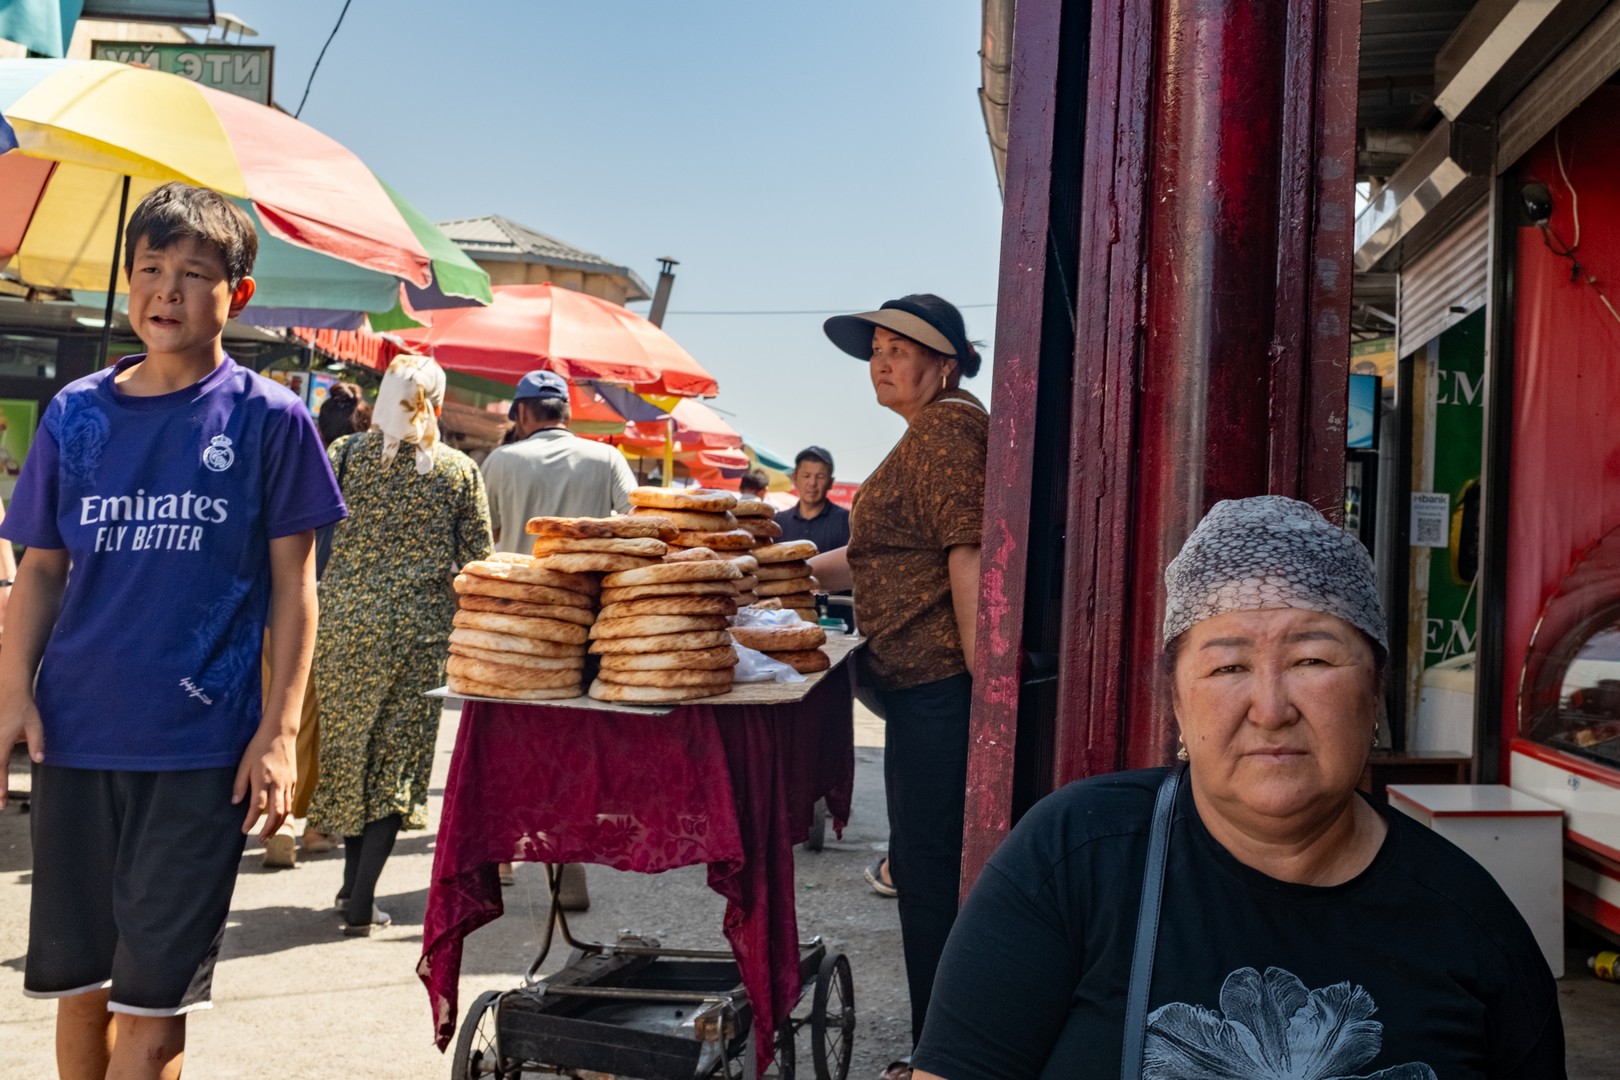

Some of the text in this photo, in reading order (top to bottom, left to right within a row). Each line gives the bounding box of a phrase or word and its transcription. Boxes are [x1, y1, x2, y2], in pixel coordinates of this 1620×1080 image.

[176, 52, 261, 84] ЭТИ
[80, 489, 228, 525] Emirates
[94, 524, 203, 552] FLY BETTER
